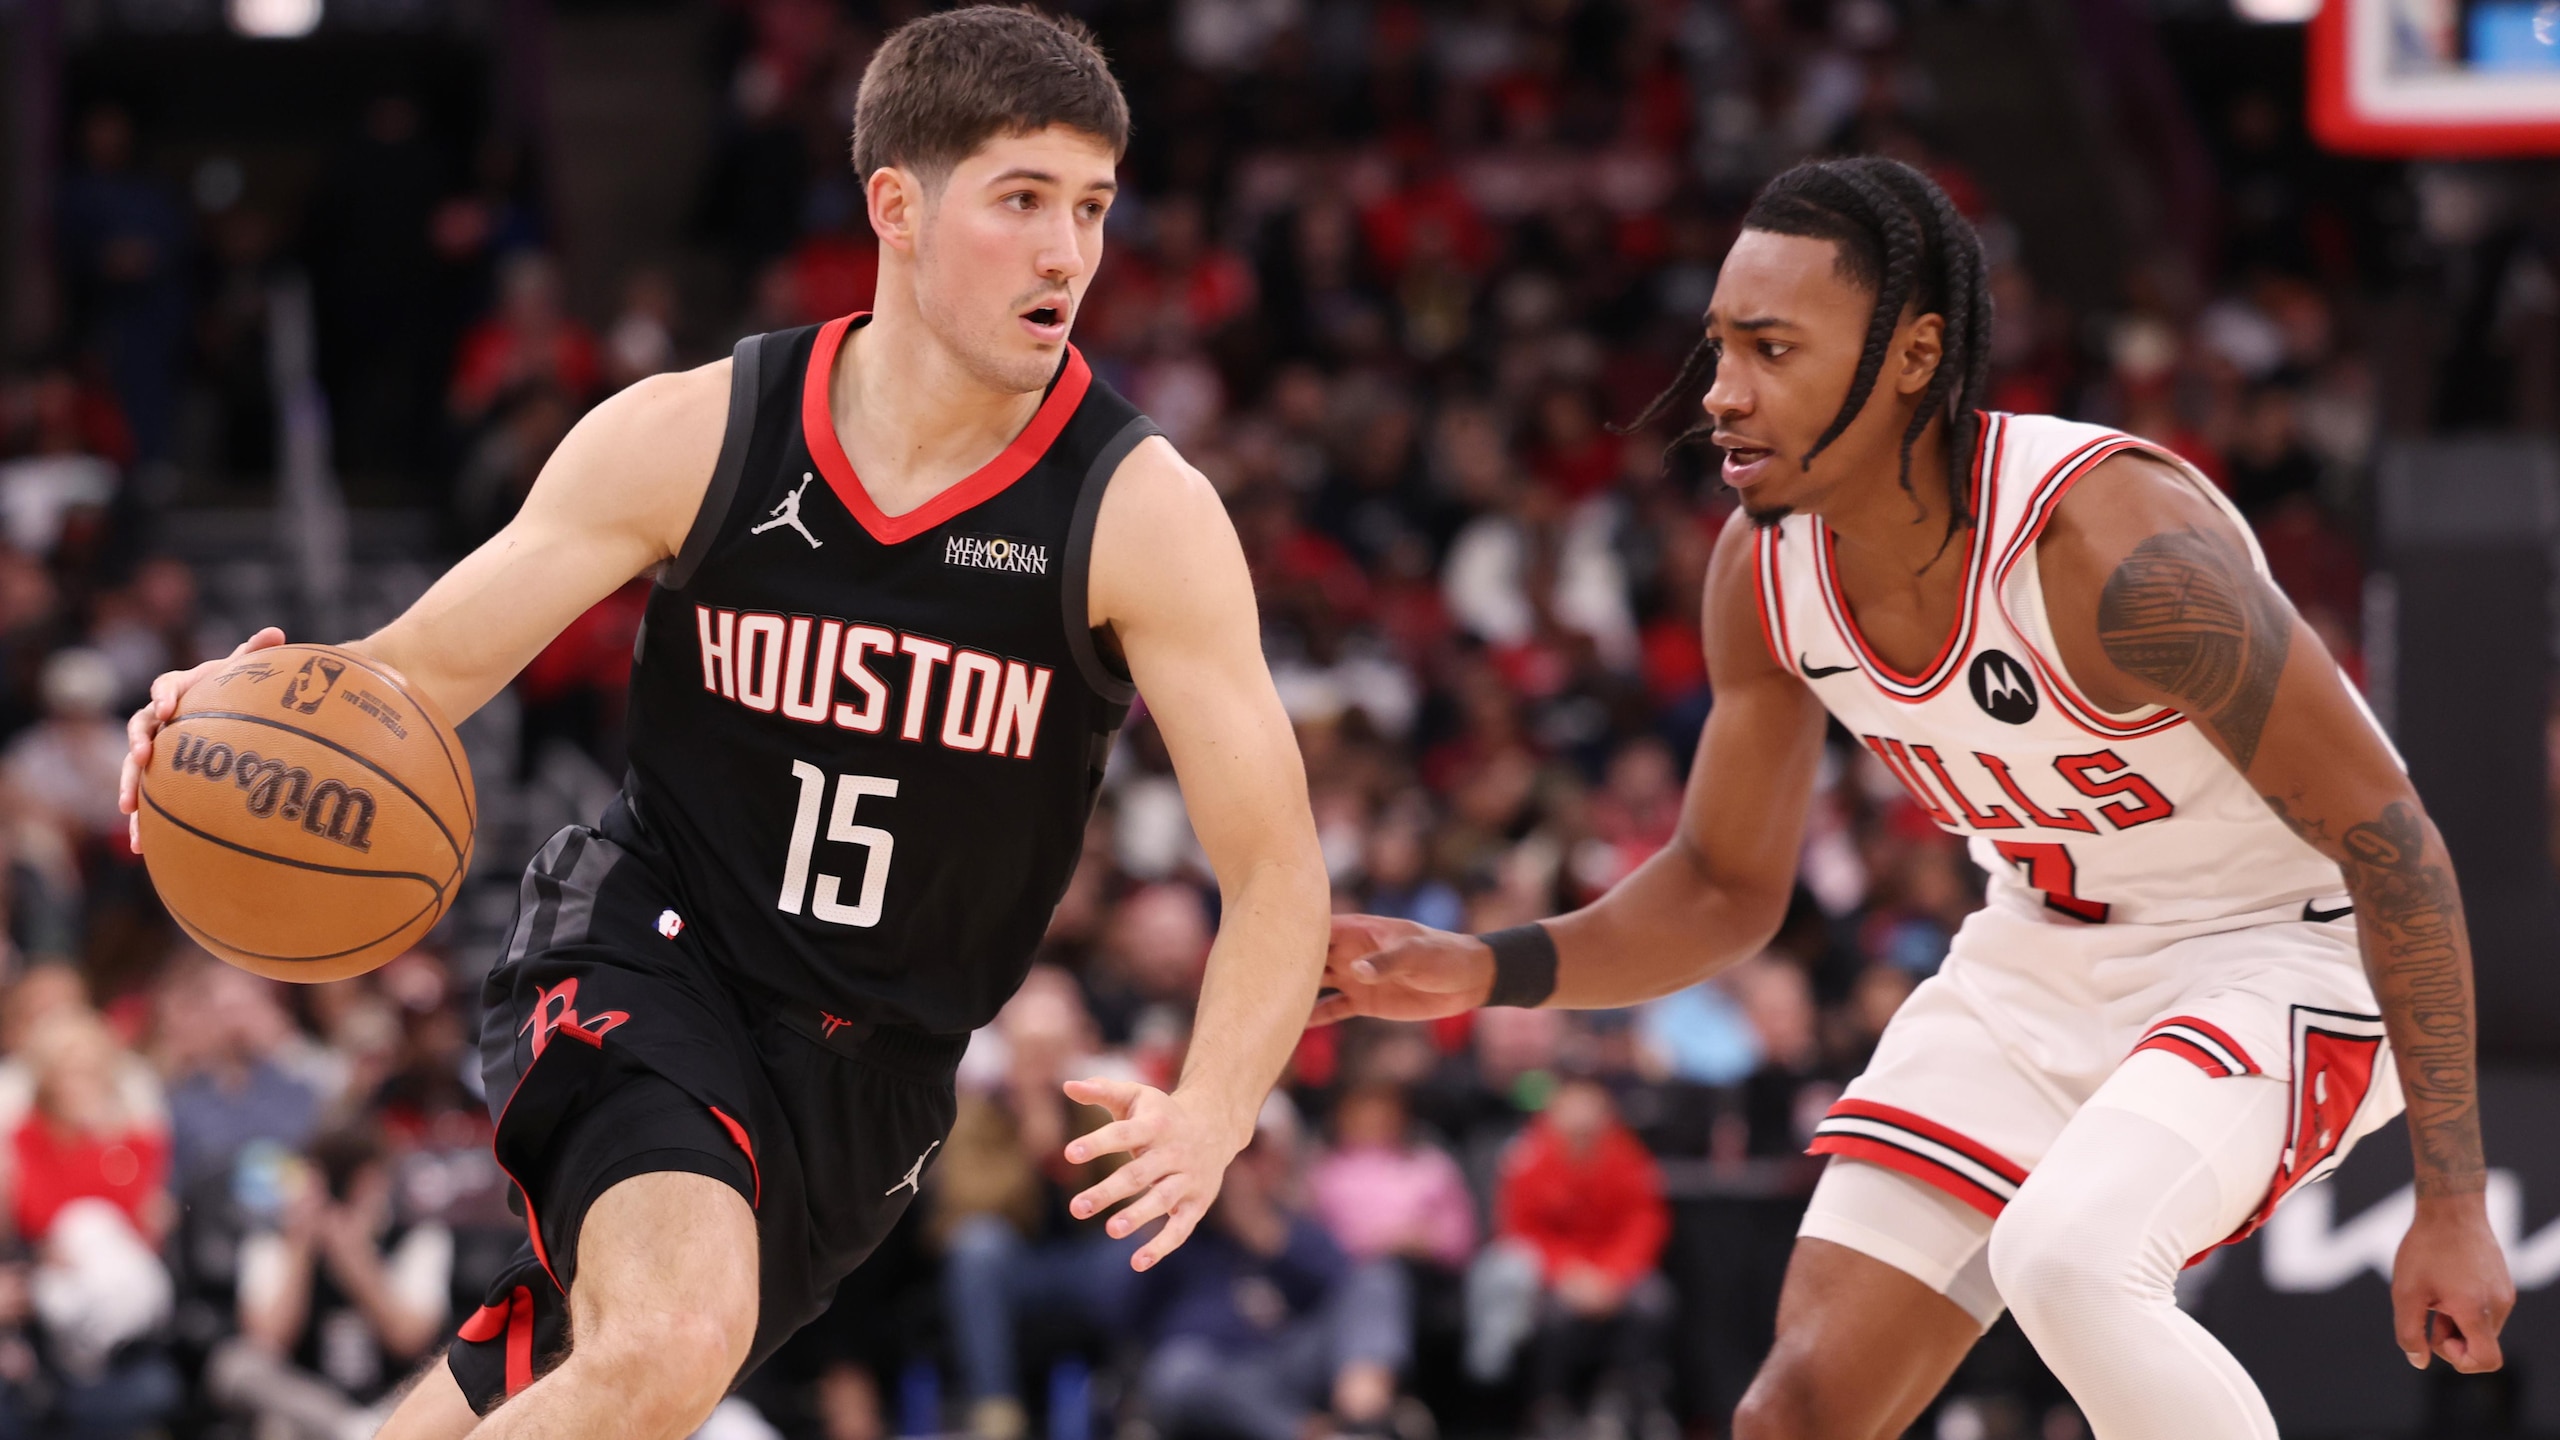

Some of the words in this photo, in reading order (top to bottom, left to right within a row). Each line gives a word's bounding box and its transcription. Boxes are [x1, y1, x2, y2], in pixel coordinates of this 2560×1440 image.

[944, 548, 1046, 575] HERMANN
[946, 535, 1049, 562] MEMORIAL
[696, 604, 1055, 760] HOUSTON
[172, 732, 376, 854] Wilson
[1861, 733, 2175, 836] ULLS
[778, 759, 899, 928] 15
[1990, 839, 2111, 924] 7
